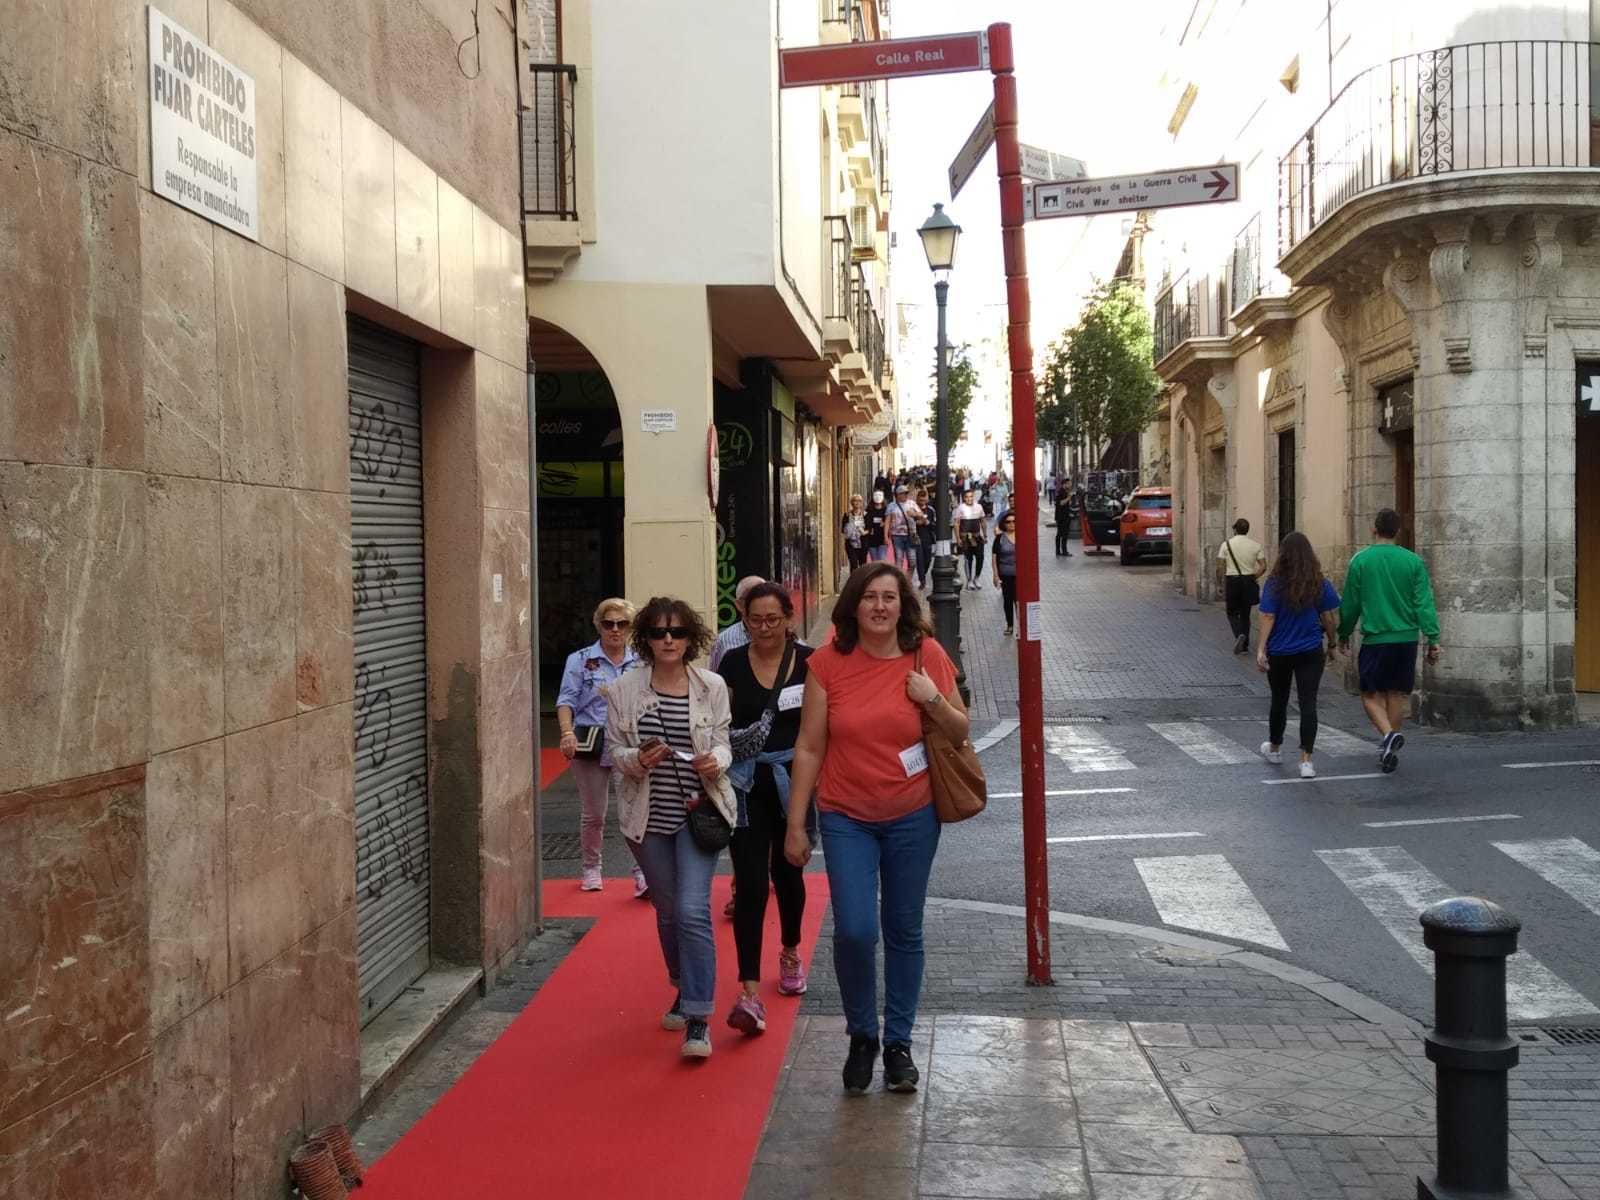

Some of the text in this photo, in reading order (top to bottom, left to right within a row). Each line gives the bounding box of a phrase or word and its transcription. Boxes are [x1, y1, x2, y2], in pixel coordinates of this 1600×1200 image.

[162, 23, 246, 114] PROHIBIDO
[875, 48, 945, 66] Calle Real
[154, 63, 255, 160] FIJAR CARTELES
[177, 136, 238, 193] Responsable la
[1110, 181, 1121, 191] de
[1128, 180, 1137, 190] la
[1143, 178, 1172, 189] Guerra
[165, 169, 250, 228] empresa anunciadora
[1093, 197, 1110, 207] War
[1118, 194, 1149, 205] shelter
[718, 429, 745, 456] 24
